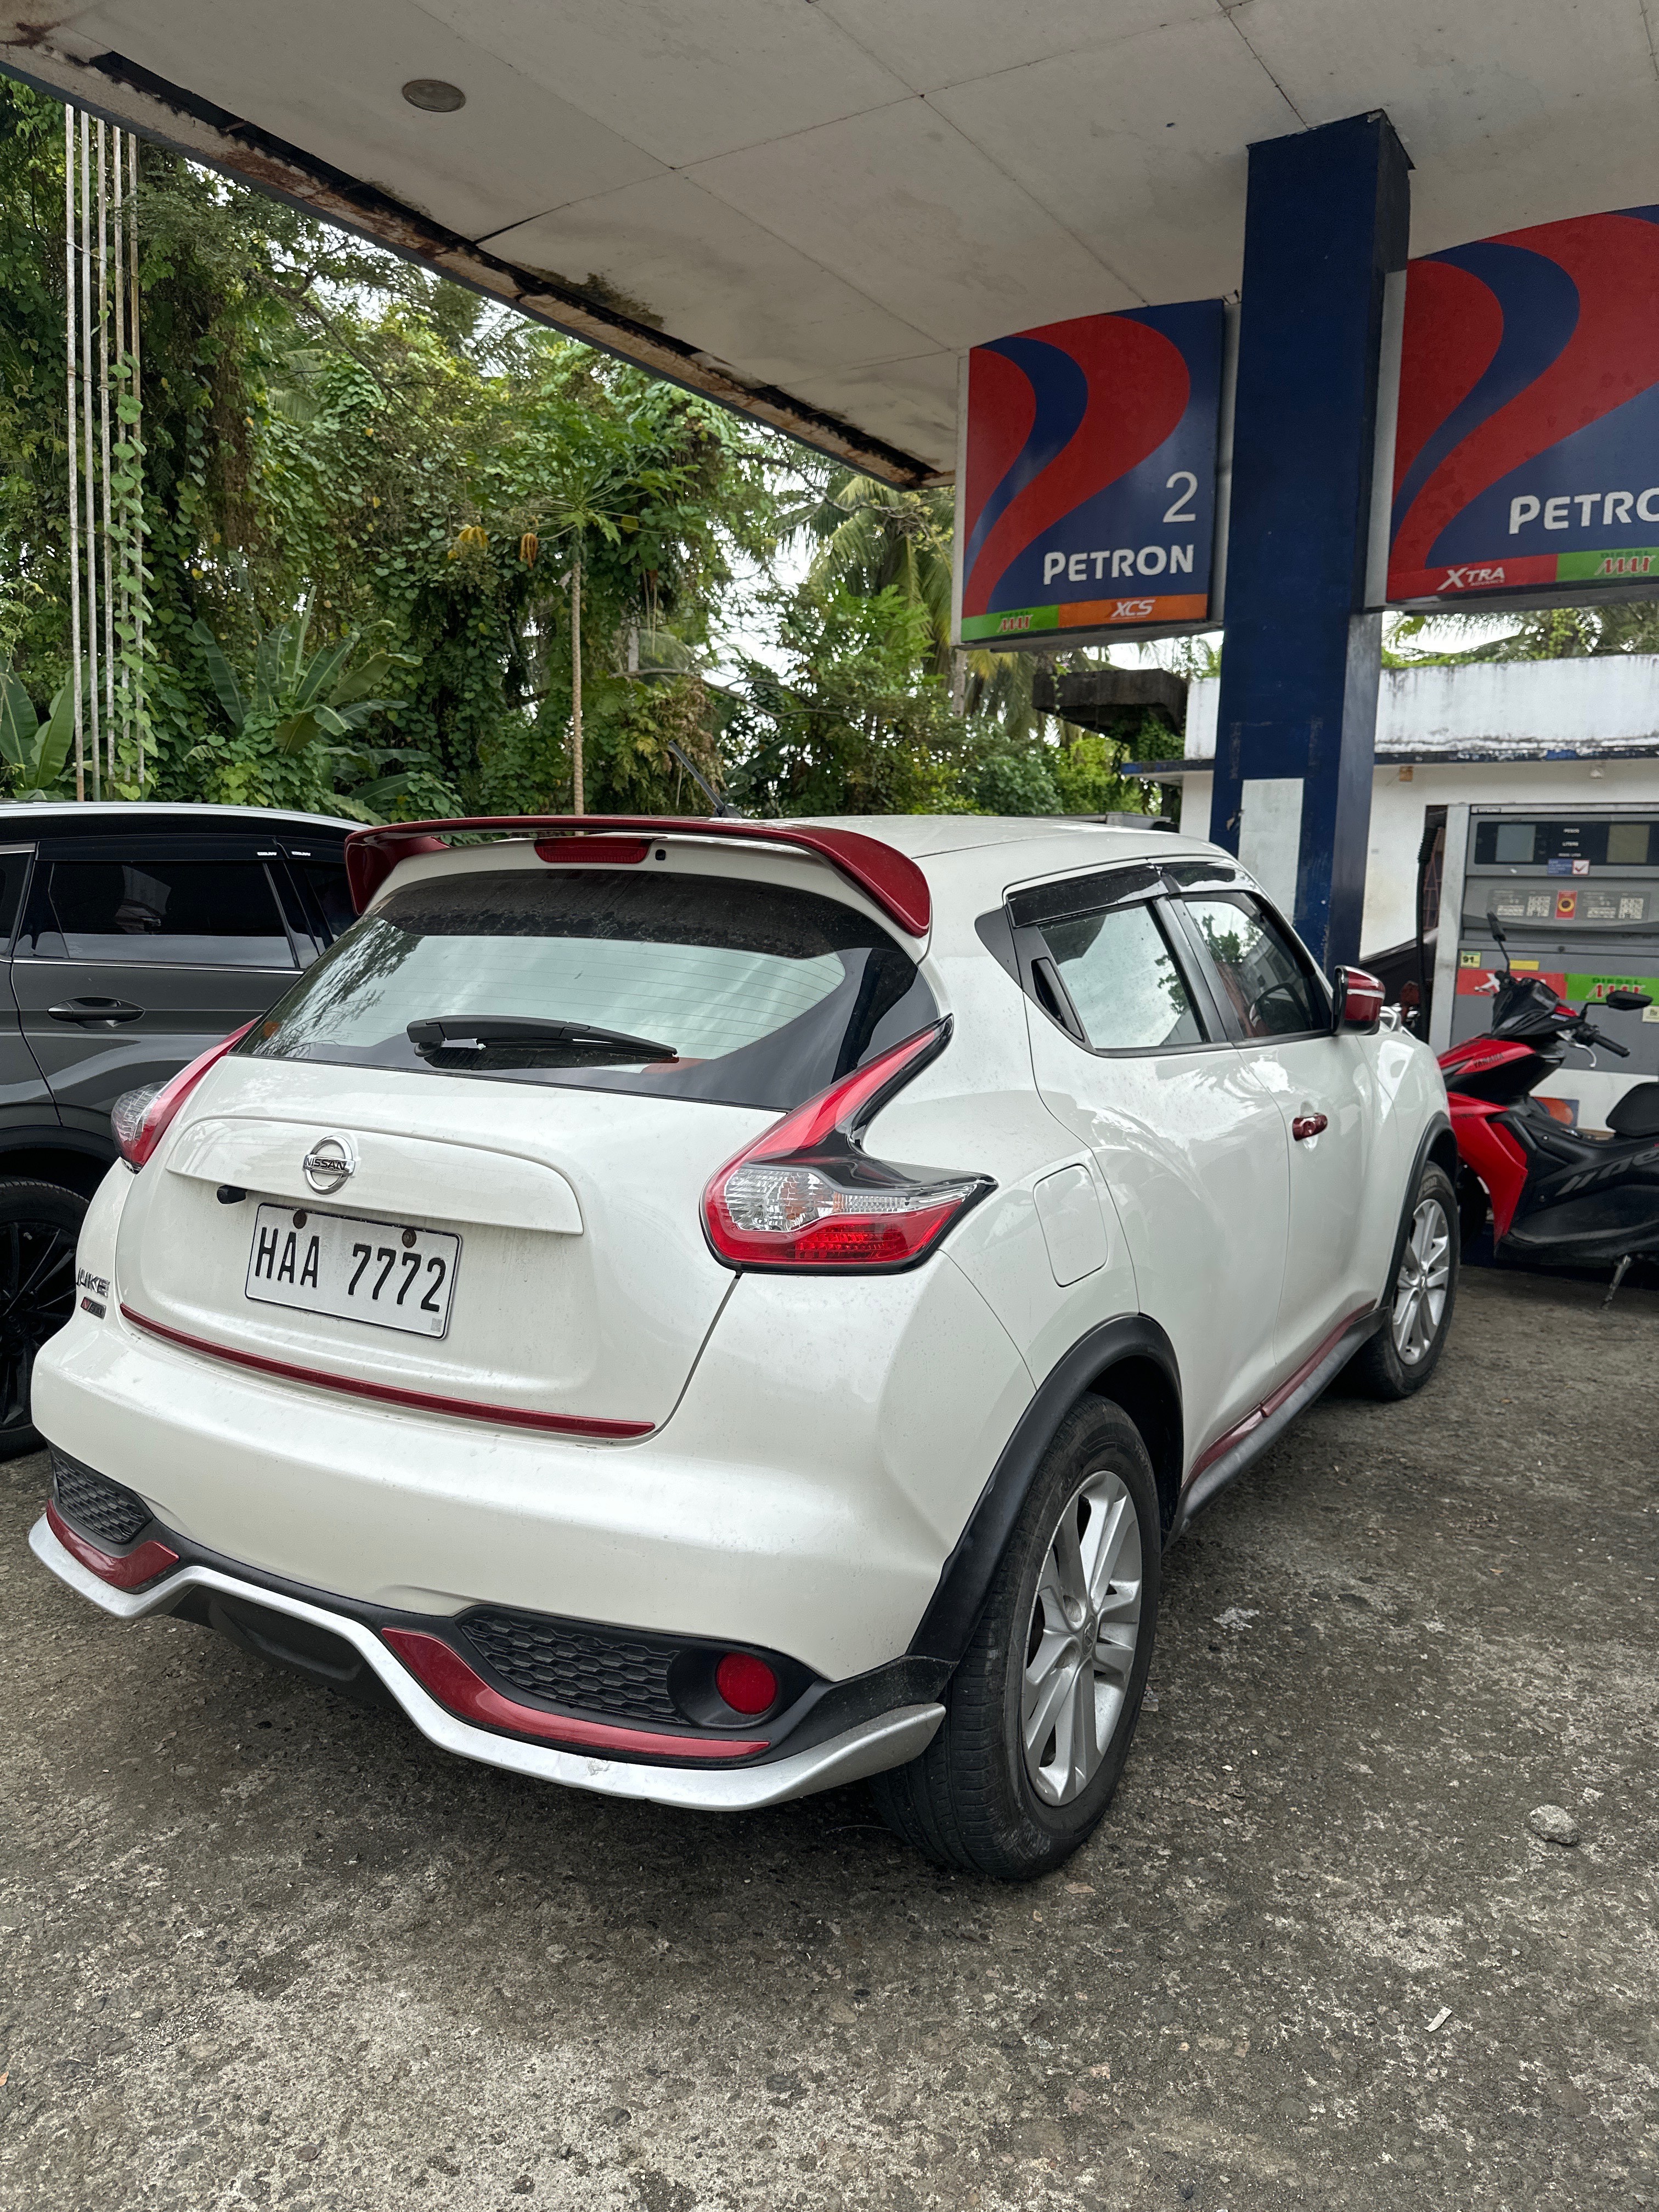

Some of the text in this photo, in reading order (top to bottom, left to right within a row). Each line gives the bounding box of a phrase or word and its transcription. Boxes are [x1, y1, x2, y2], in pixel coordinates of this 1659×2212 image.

[1163, 471, 1198, 523] 2
[1043, 544, 1194, 585] PETRON
[1436, 567, 1505, 591] XTRA
[1110, 600, 1155, 618] XCS
[1592, 977, 1641, 985] DIESEL
[1473, 1053, 1504, 1069] YAMAHA
[307, 1156, 348, 1171] NISSAN
[255, 1227, 446, 1312] HAA 7772
[76, 1267, 110, 1298] JUKE
